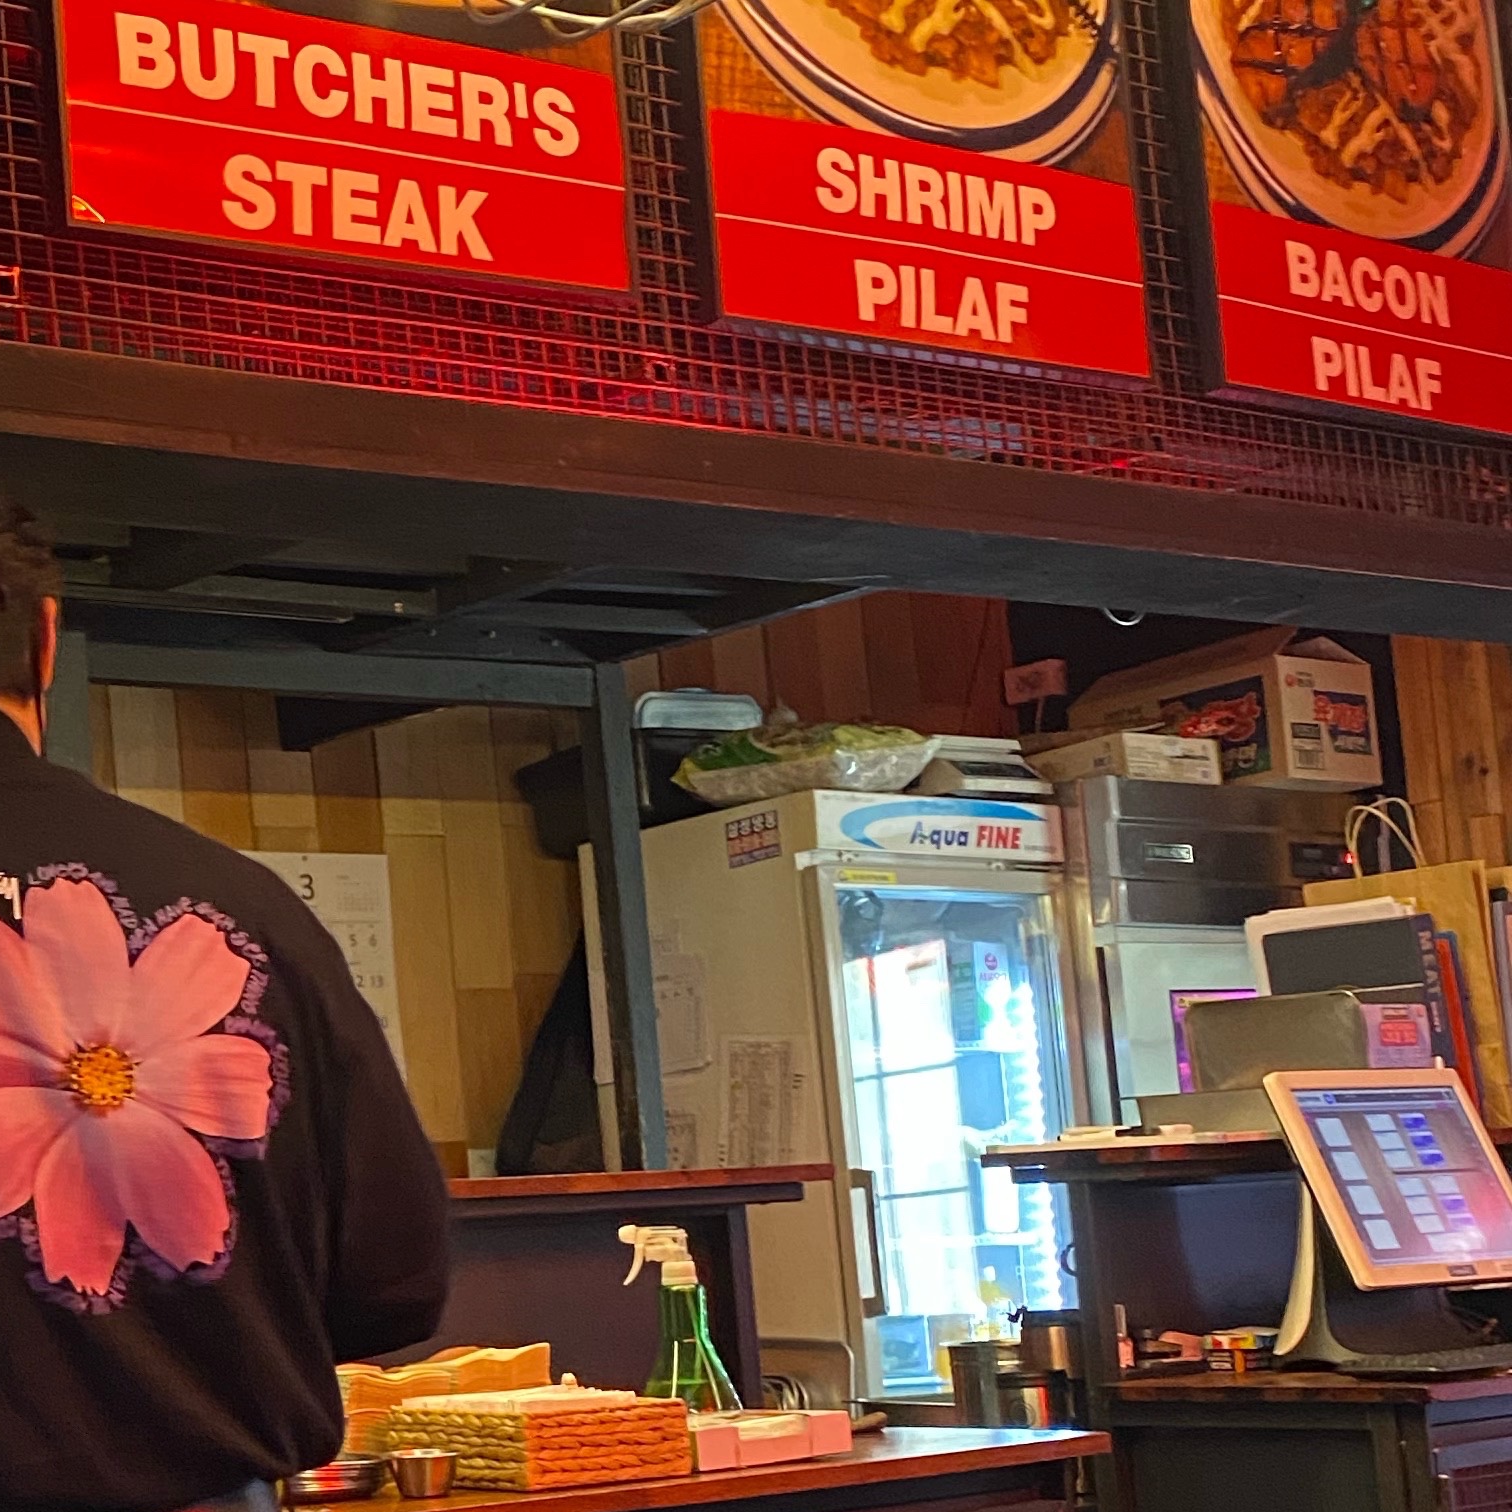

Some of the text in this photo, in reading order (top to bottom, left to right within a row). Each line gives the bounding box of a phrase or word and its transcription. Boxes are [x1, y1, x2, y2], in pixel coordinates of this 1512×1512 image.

[115, 12, 579, 157] BUTCHER'S
[222, 154, 493, 261] STEAK
[815, 147, 1056, 246] SHRIMP
[854, 259, 1028, 343] PILAF
[1285, 240, 1451, 328] BACON
[1311, 335, 1443, 411] PILAF
[910, 821, 1022, 850] Aqua FINE
[299, 874, 315, 900] 3
[349, 934, 377, 947] 5 6
[370, 975, 384, 988] 13
